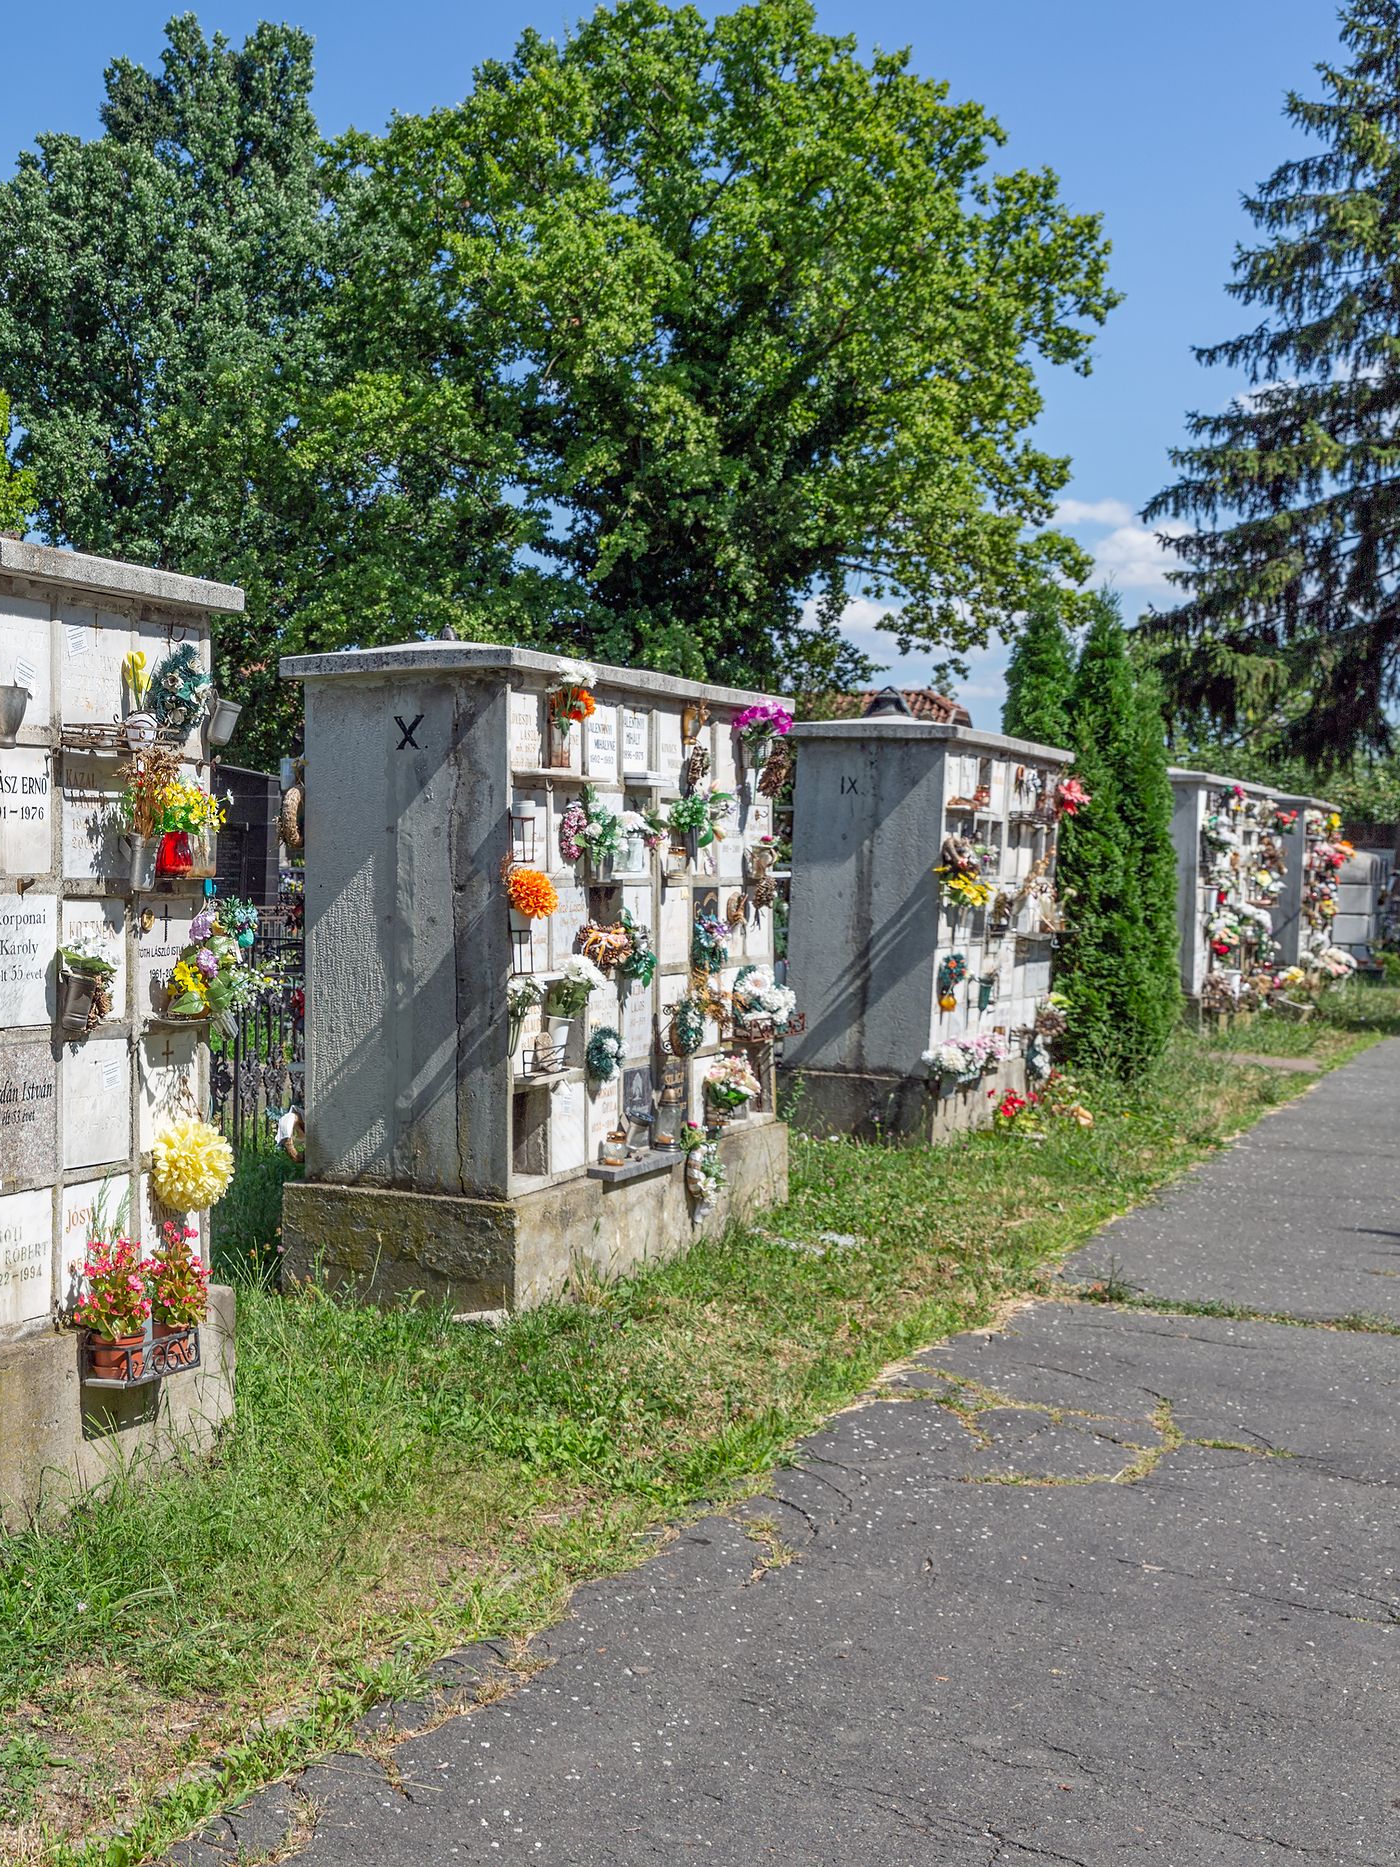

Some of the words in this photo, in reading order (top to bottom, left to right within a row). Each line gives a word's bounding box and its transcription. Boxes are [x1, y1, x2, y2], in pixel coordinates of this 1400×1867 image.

[0, 938, 39, 961] Károly
[10, 963, 24, 982] 55
[21, 1077, 53, 1101] István
[4, 1241, 49, 1265] RÓBERT
